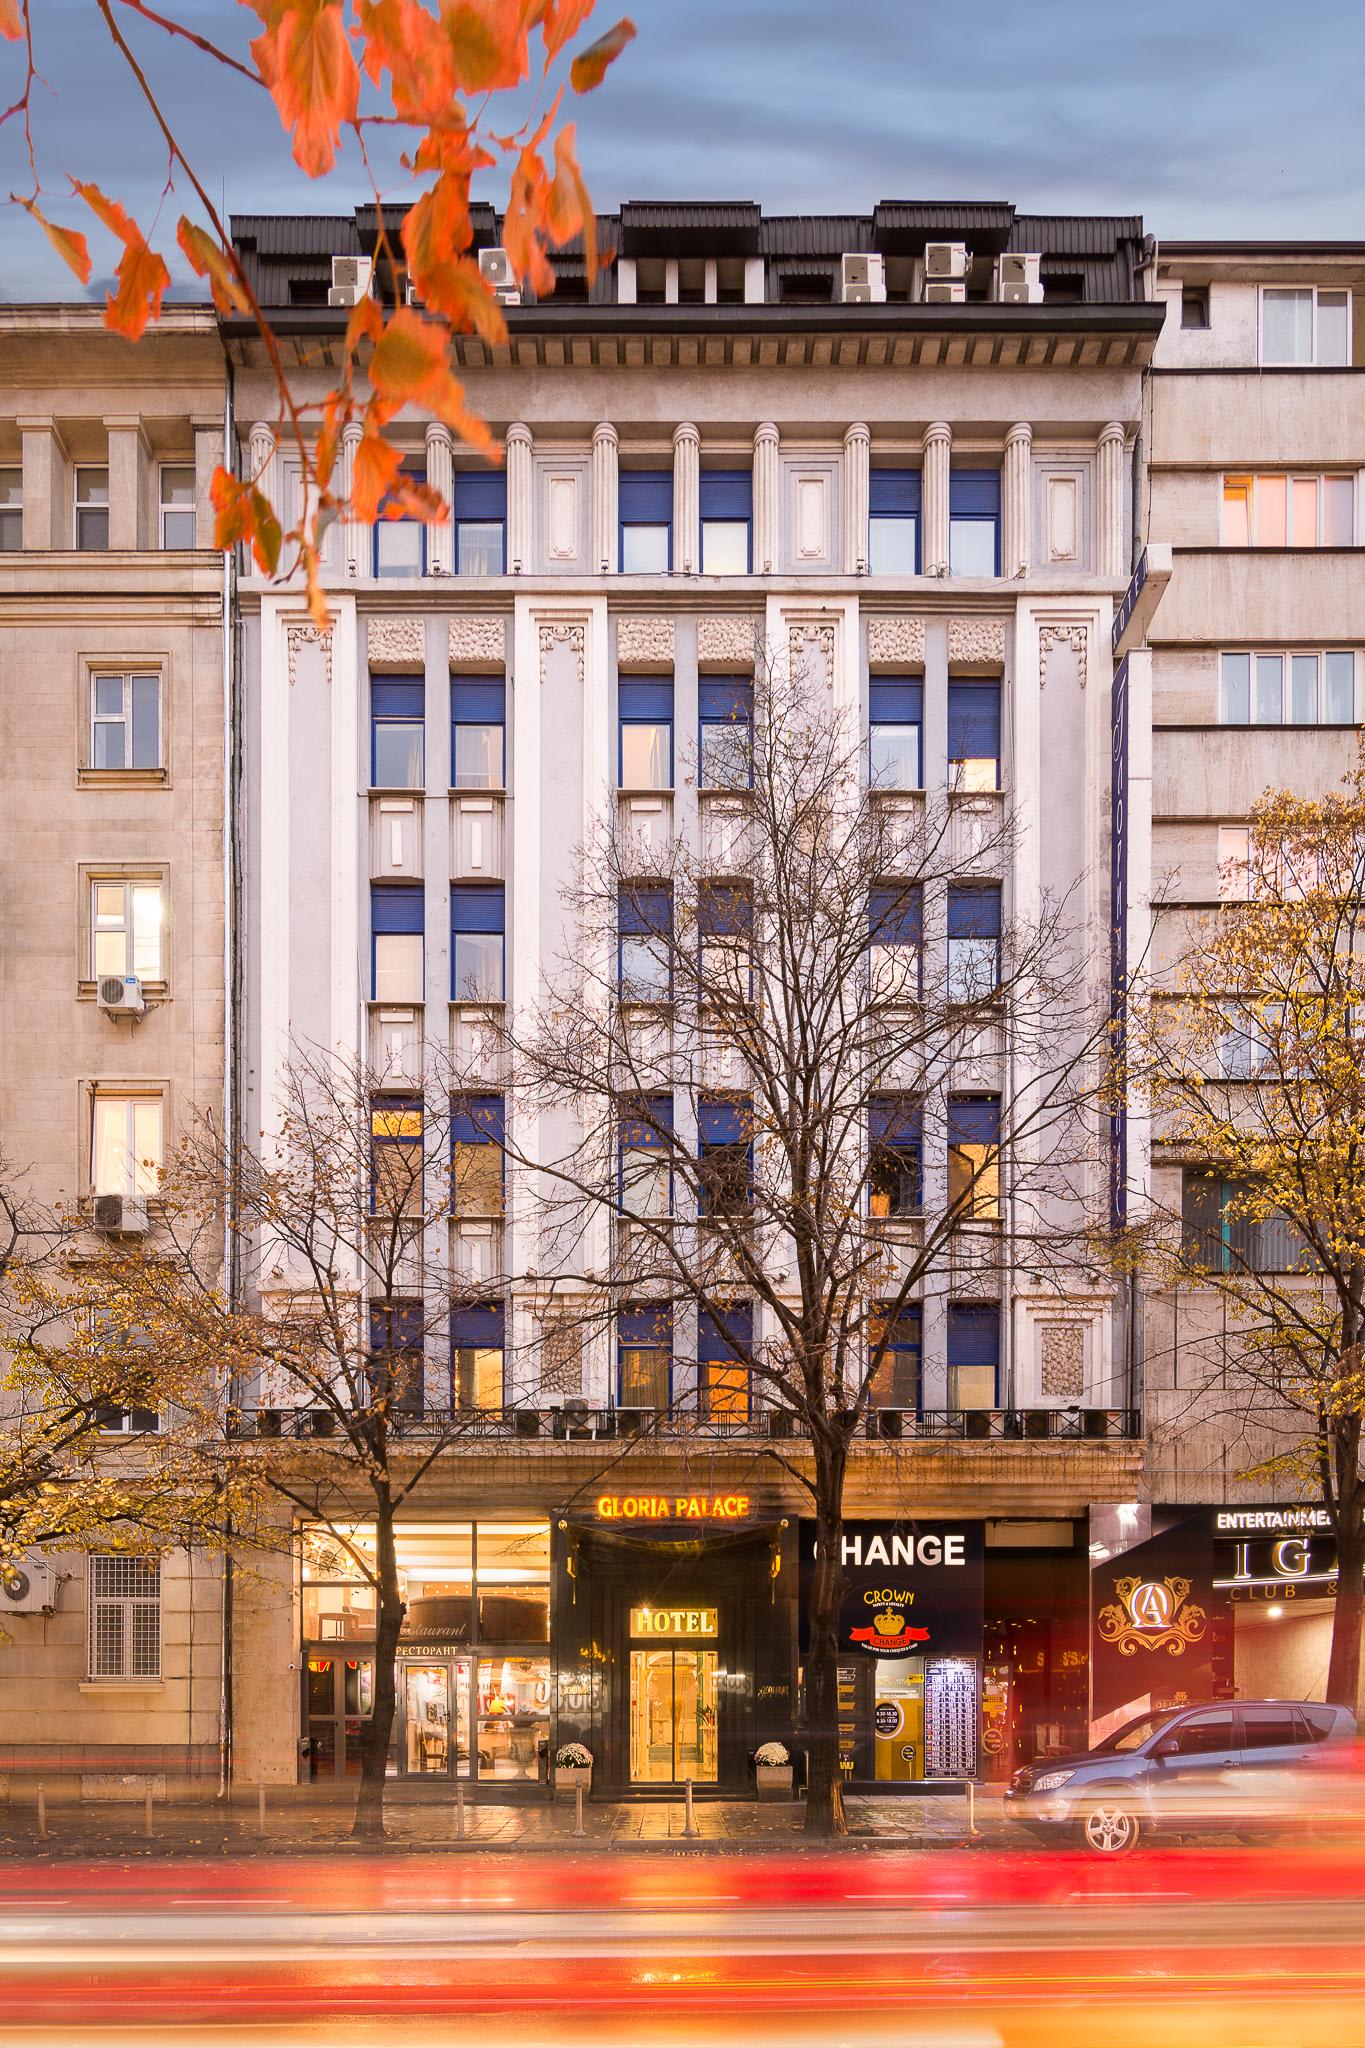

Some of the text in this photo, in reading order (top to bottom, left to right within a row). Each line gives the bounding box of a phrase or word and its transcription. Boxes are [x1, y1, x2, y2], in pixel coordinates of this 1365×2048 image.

[598, 1498, 749, 1517] GLORIA PALACE
[813, 1535, 966, 1566] HANGE
[864, 1589, 914, 1604] CROWN
[1230, 1580, 1339, 1601] CLUB &
[637, 1611, 714, 1633] HOTEL
[395, 1646, 459, 1656] РЕСТОРАНТ
